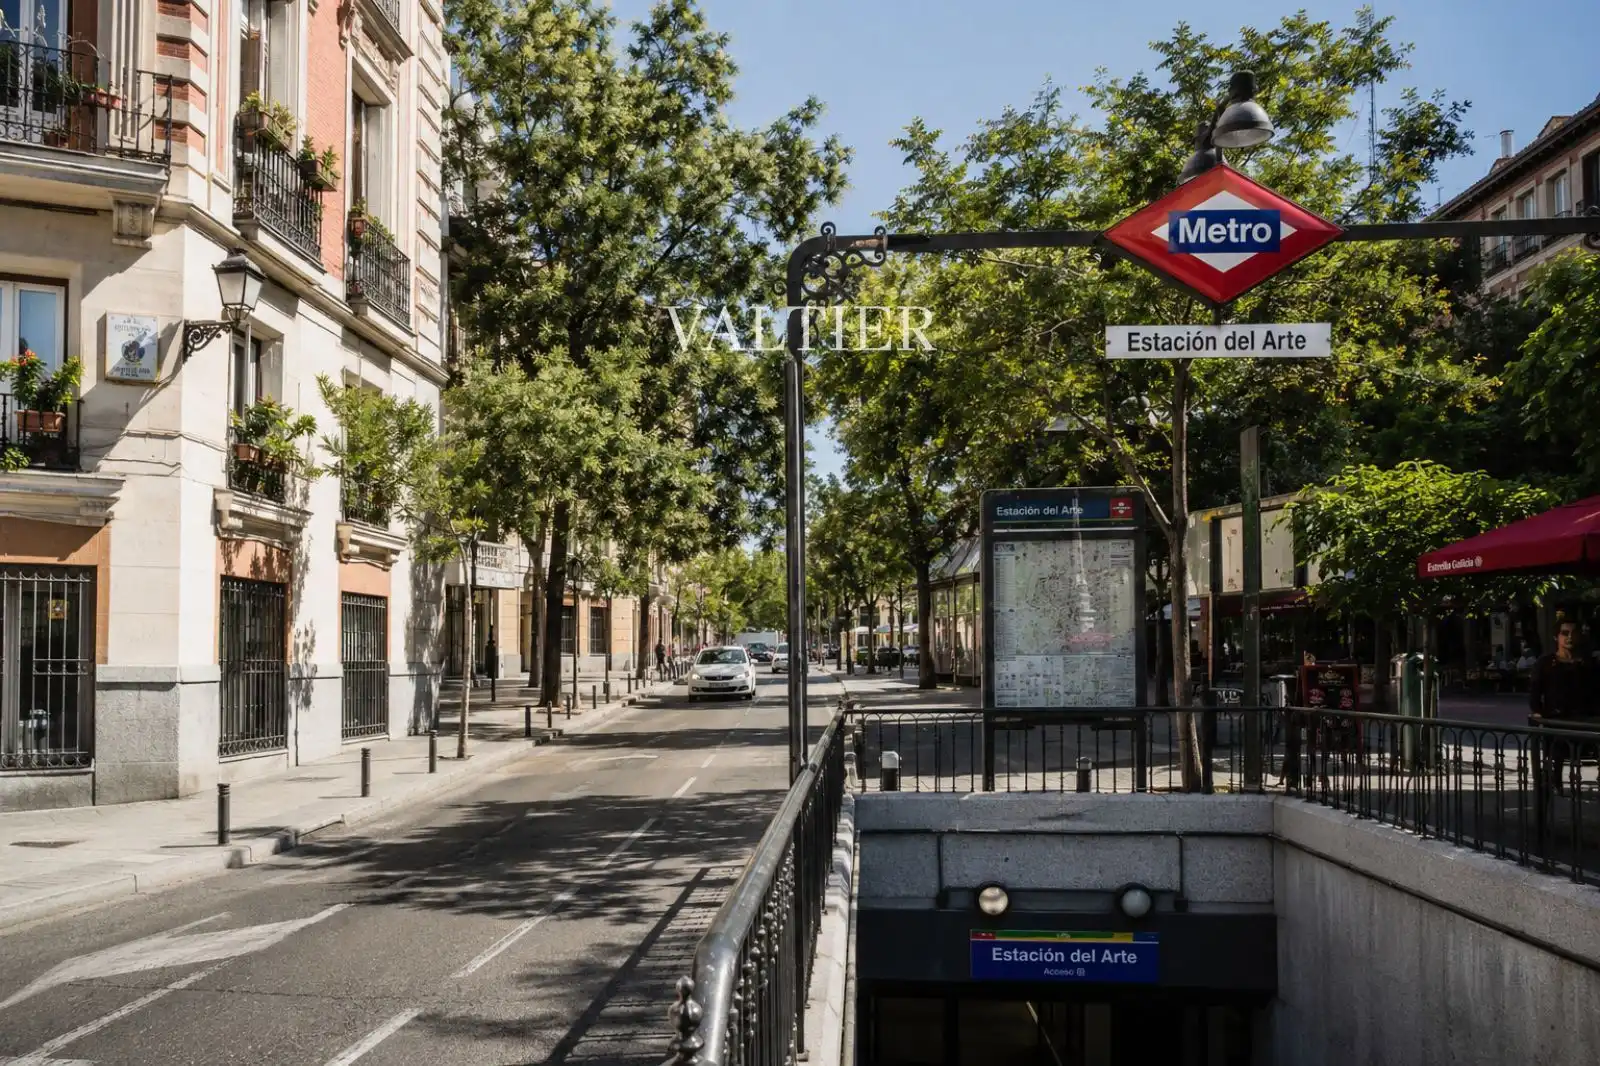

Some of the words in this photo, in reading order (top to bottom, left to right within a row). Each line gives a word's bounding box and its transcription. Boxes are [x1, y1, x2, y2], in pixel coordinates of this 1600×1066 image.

[1179, 217, 1272, 243] Metro
[1127, 330, 1217, 351] Estación
[1224, 331, 1255, 351] del
[1262, 330, 1307, 350] Arte
[996, 505, 1040, 516] Estación
[1043, 506, 1058, 515] del
[1061, 505, 1083, 515] Arte
[992, 947, 1065, 963] Estación
[1070, 949, 1096, 963] del
[1101, 949, 1138, 964] Arte
